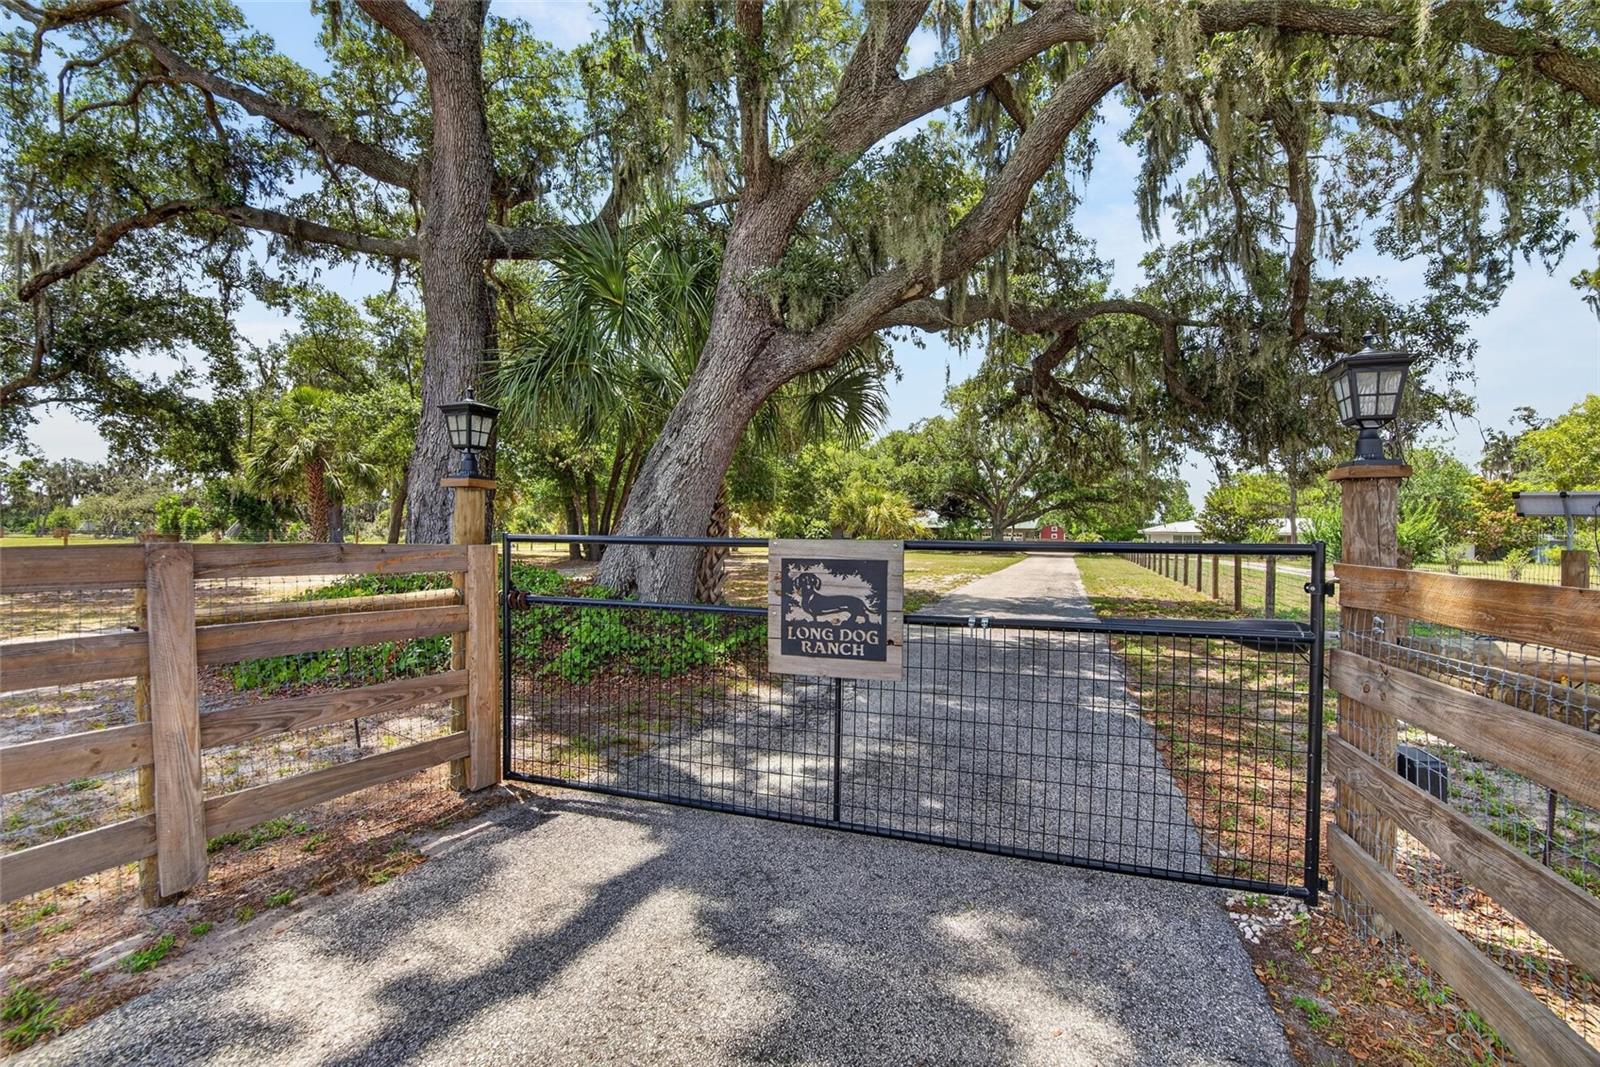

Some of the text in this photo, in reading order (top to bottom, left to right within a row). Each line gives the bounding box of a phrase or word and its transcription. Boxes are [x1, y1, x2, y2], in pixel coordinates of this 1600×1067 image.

[787, 626, 879, 645] LONG DOG
[801, 640, 865, 656] RANCH
